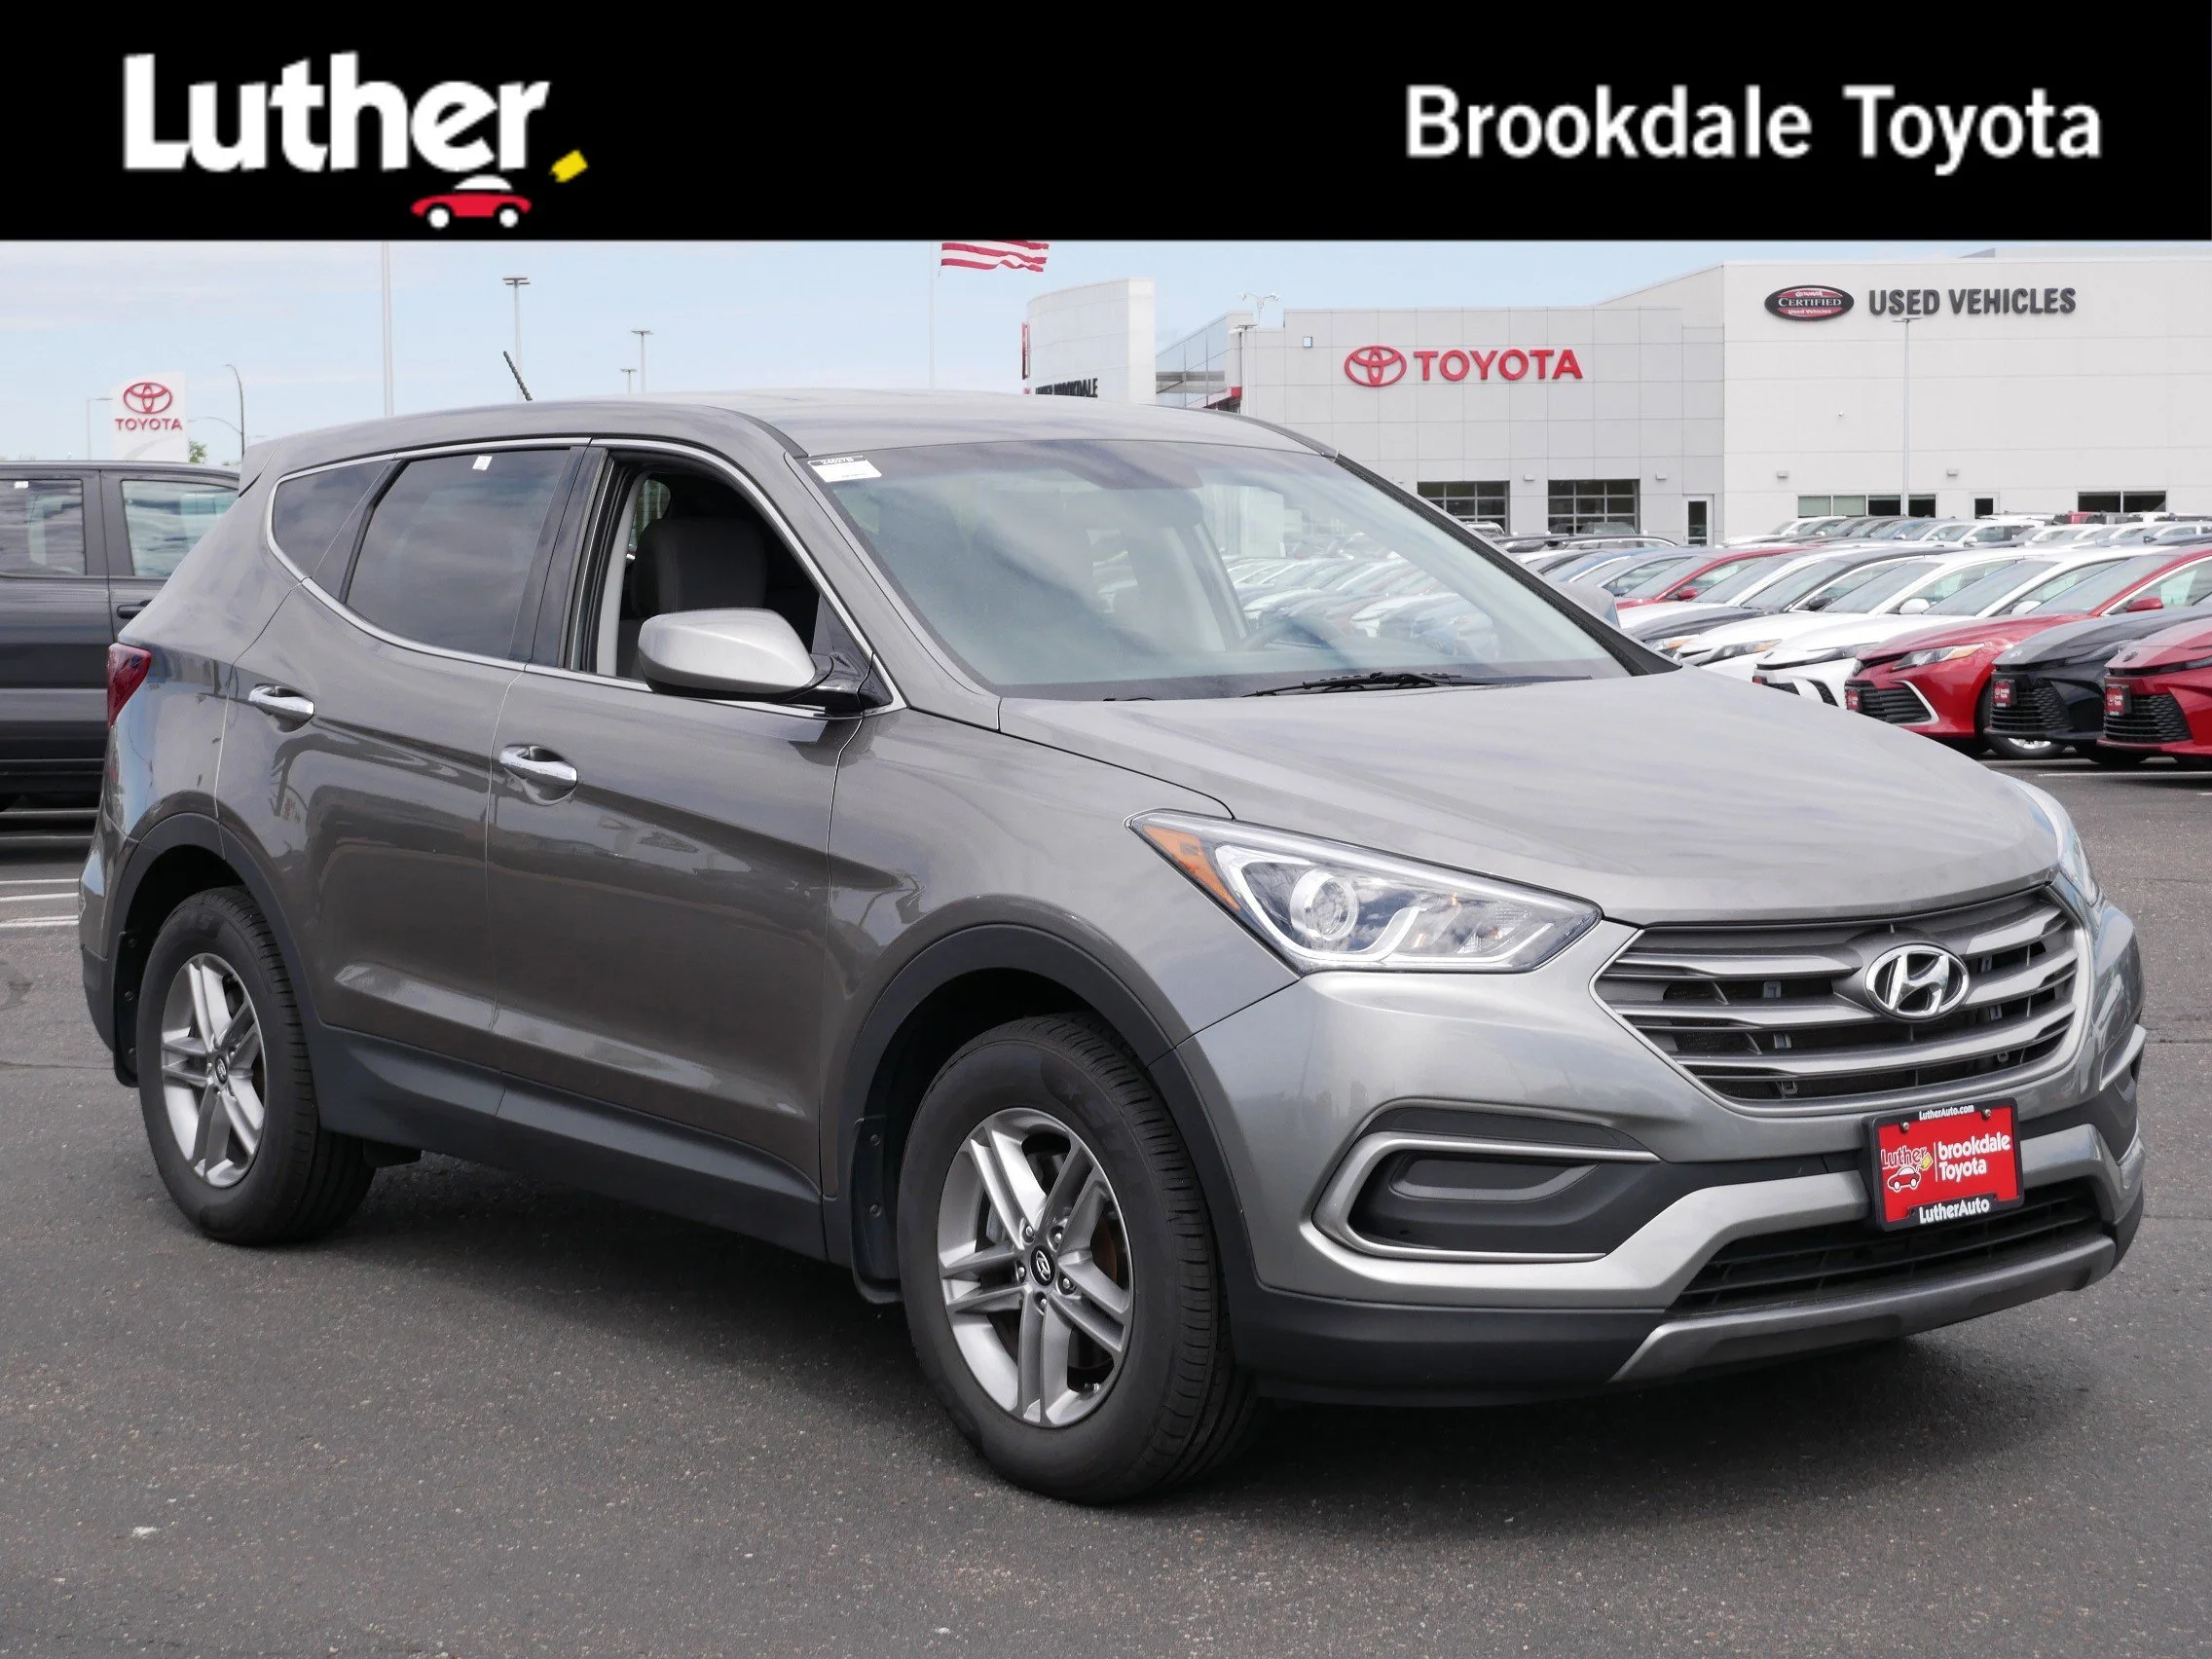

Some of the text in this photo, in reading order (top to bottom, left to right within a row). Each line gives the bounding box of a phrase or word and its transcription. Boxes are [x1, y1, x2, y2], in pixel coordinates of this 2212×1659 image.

[1869, 288, 2077, 314] USED VEHICLES
[1414, 349, 1583, 381] TOYOTA
[115, 418, 183, 430] TOYOTA
[1919, 1104, 1974, 1121] LutherAuto.com
[1881, 1145, 1928, 1169] Luther
[1937, 1131, 2011, 1161] brookdale
[1938, 1157, 1988, 1183] Toyota
[1919, 1198, 1990, 1224] LutherAuto
